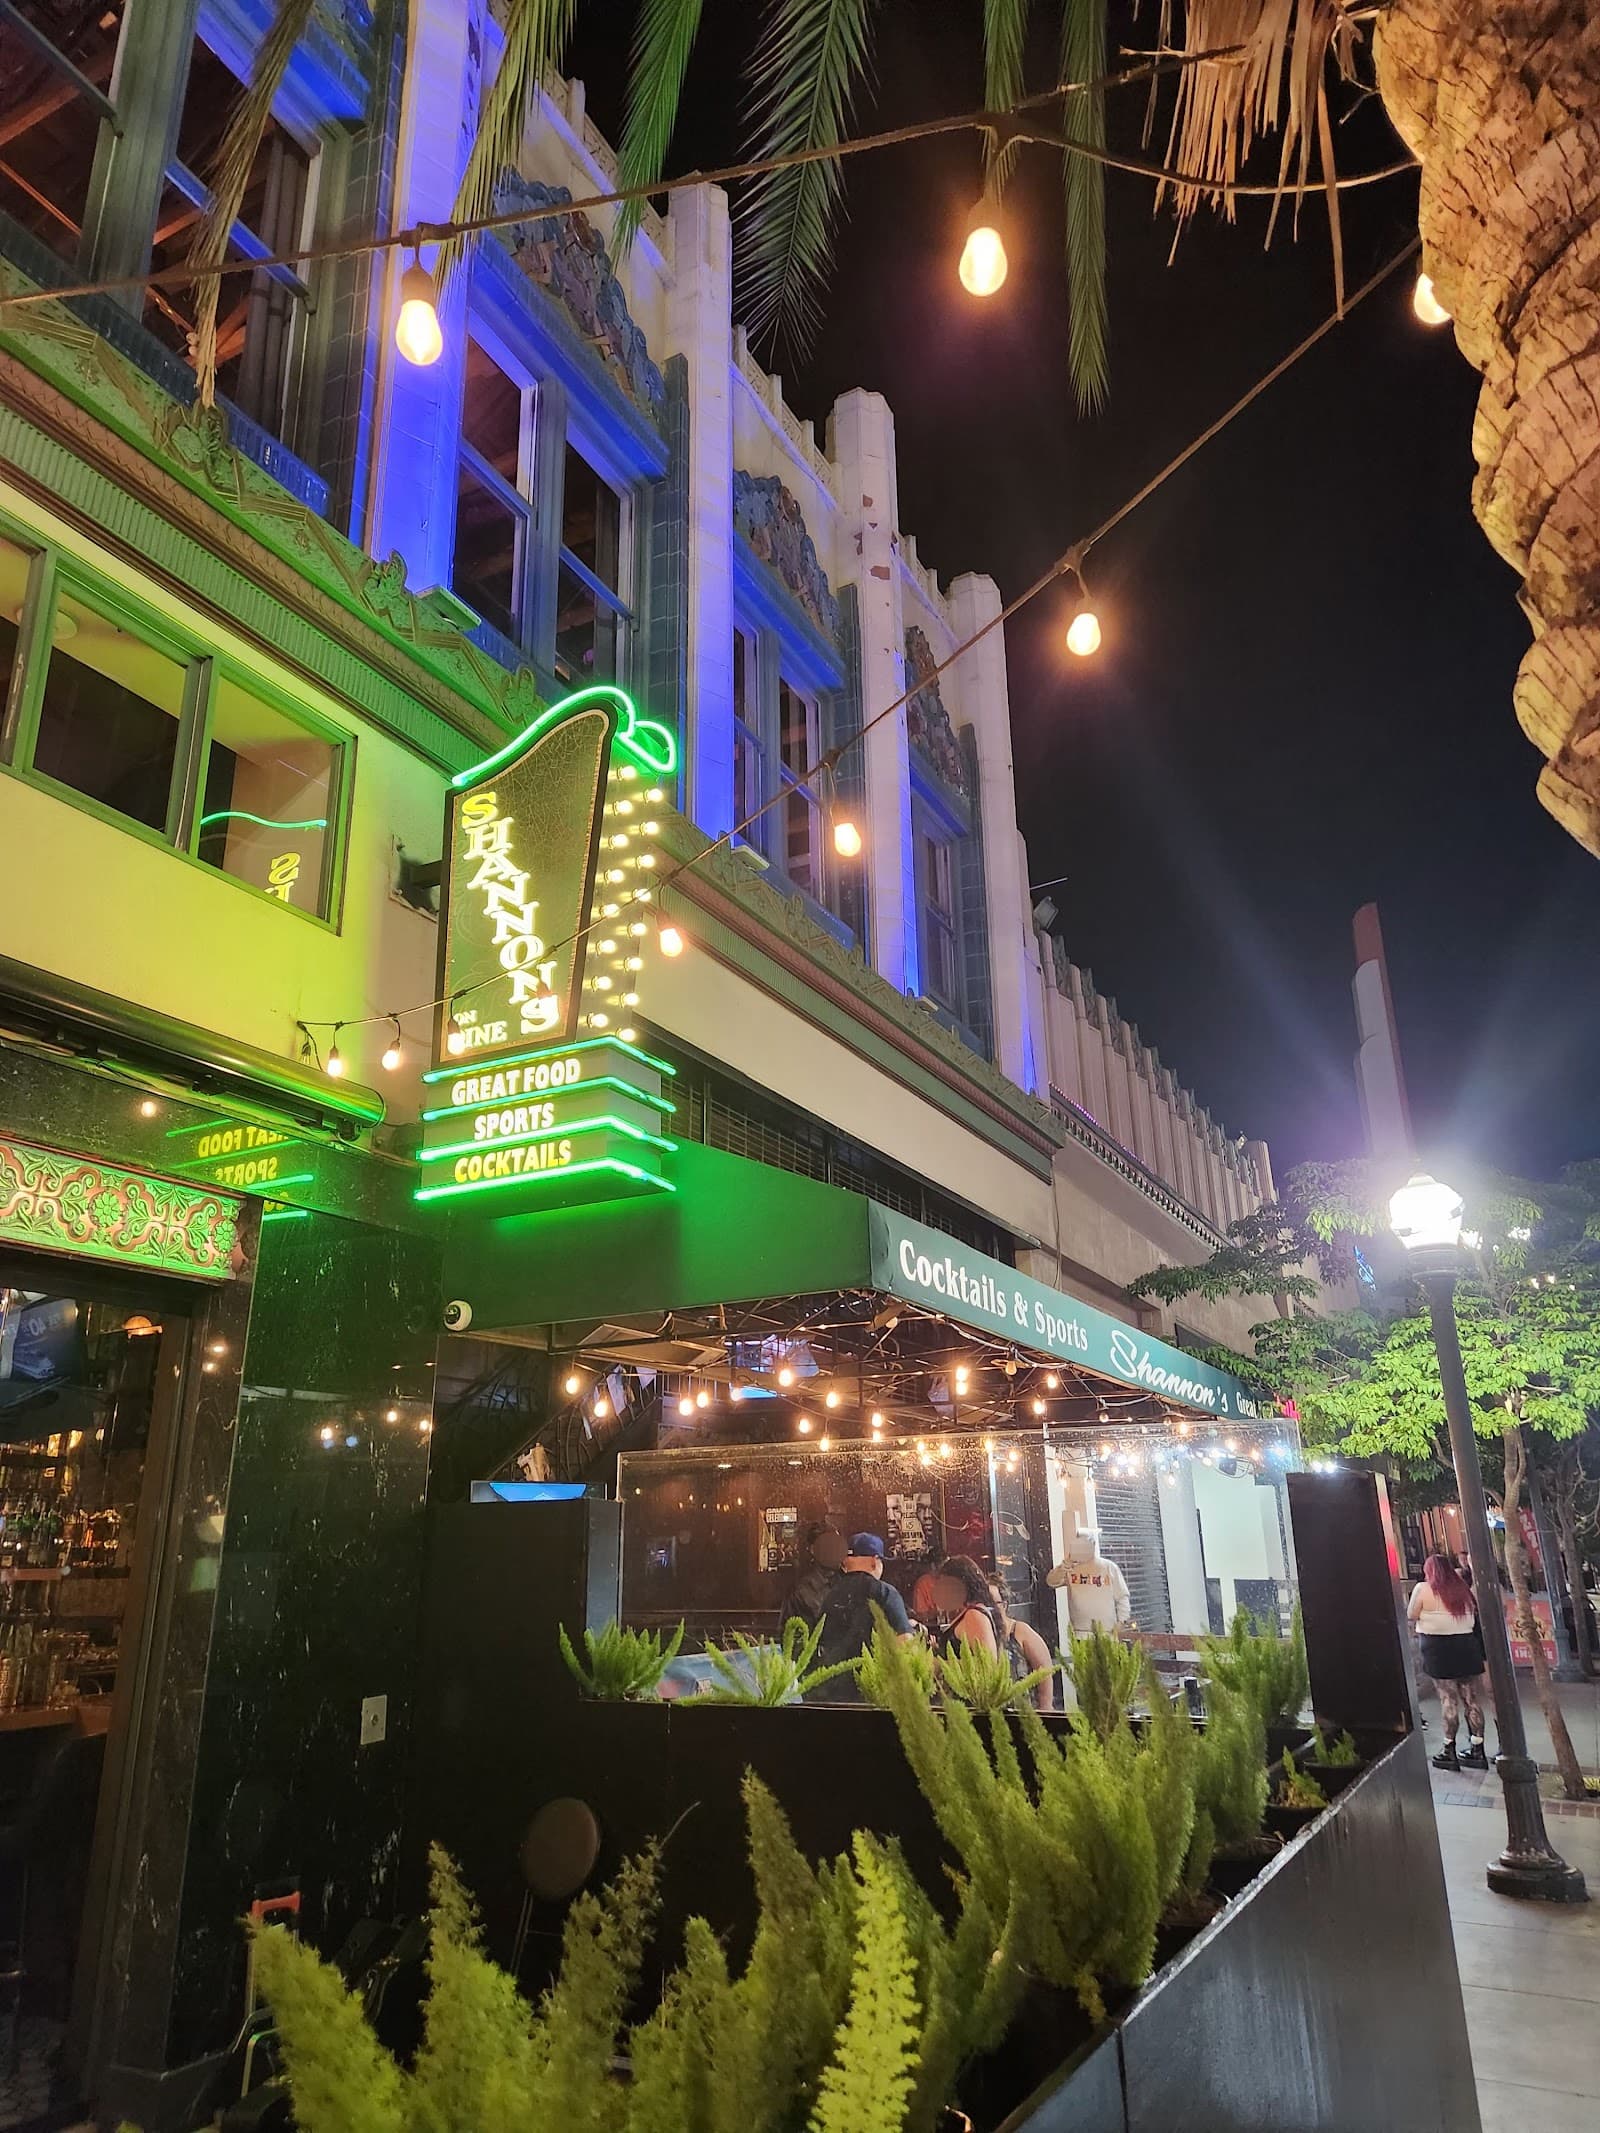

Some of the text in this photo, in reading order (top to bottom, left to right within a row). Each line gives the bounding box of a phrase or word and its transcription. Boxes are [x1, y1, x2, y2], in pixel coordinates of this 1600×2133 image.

[458, 1021, 508, 1049] INE
[451, 1058, 581, 1107] GREAT FOOD
[474, 1102, 555, 1141] SPORTS
[454, 1139, 572, 1184] COCKTAILS
[899, 1239, 1007, 1318] Cocktails
[1014, 1291, 1029, 1328] &
[1034, 1301, 1088, 1351] Sports
[1110, 1329, 1229, 1413] Shannon's
